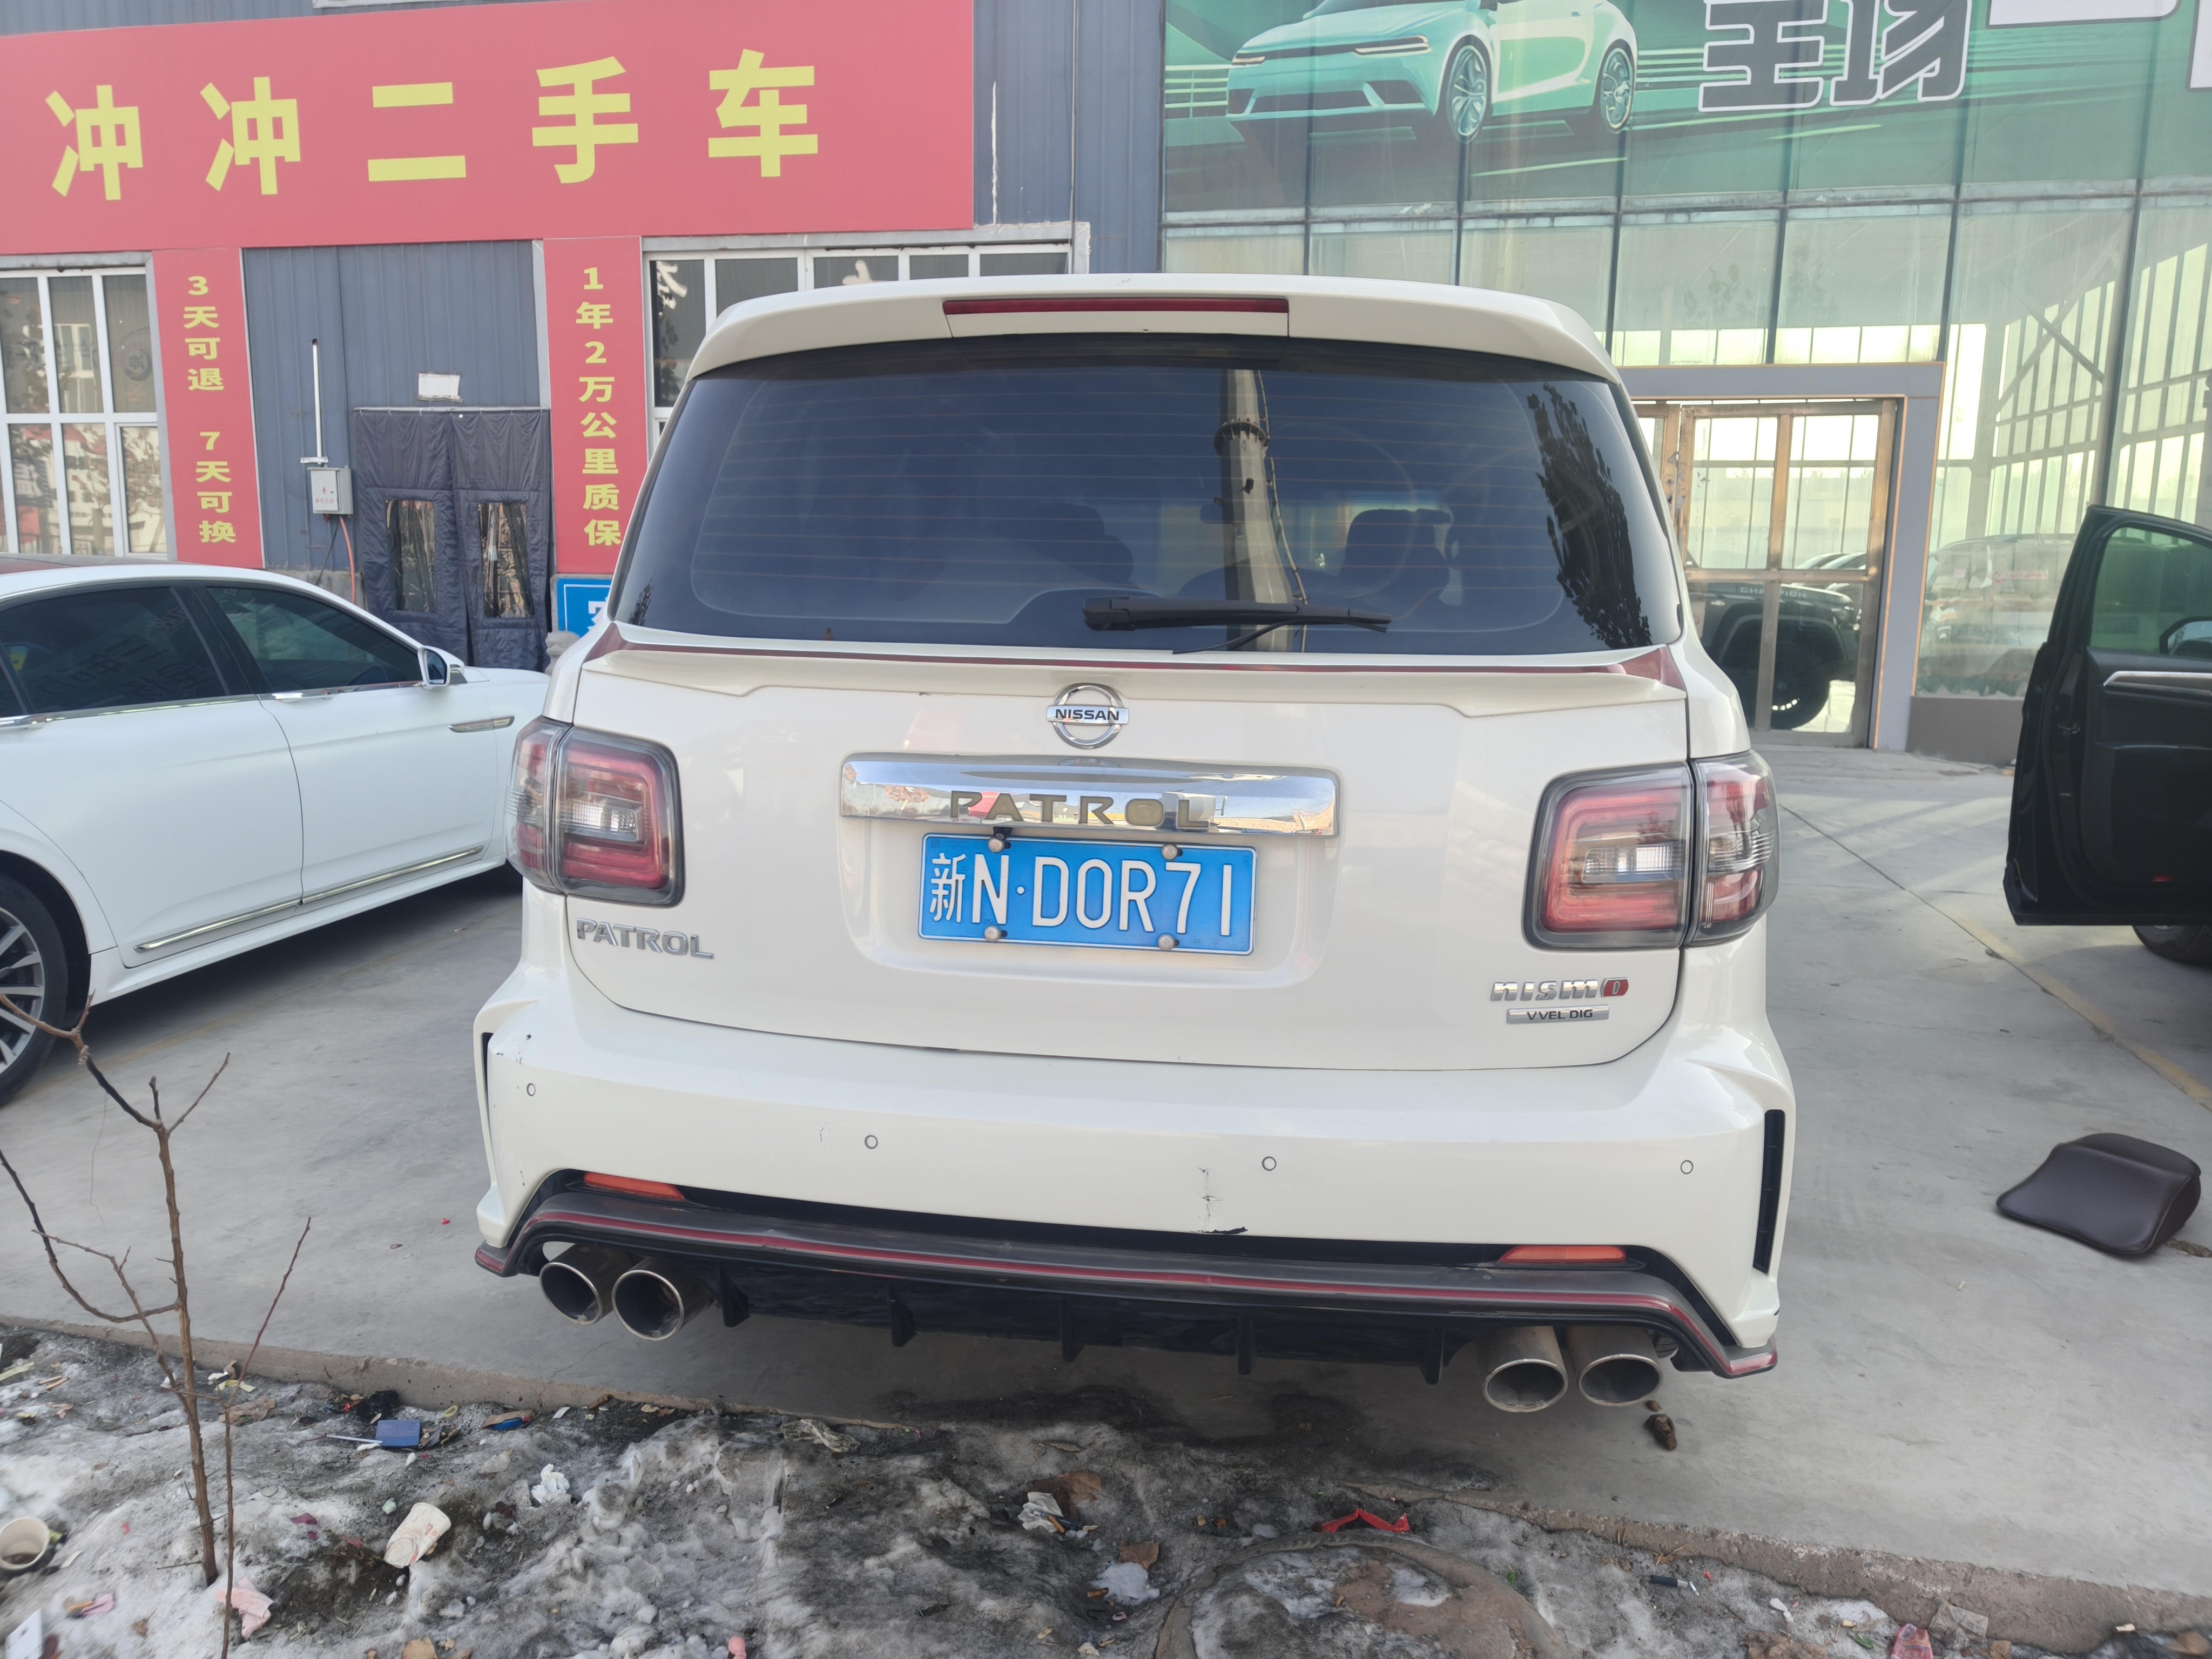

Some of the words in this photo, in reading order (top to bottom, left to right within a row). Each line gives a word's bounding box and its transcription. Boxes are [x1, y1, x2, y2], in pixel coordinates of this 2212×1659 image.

[45, 49, 819, 201] 冲冲二手车
[184, 276, 224, 391] 3天可退
[576, 267, 622, 546] 1年2万公里质保
[195, 431, 236, 543] 7天可换
[1740, 586, 1807, 598] CHAION
[1055, 709, 1120, 721] NISSAN
[950, 790, 1209, 829] PATROL
[576, 917, 714, 959] PATROL
[1527, 1010, 1566, 1021] VVEL
[1569, 1009, 1593, 1019] DIG
